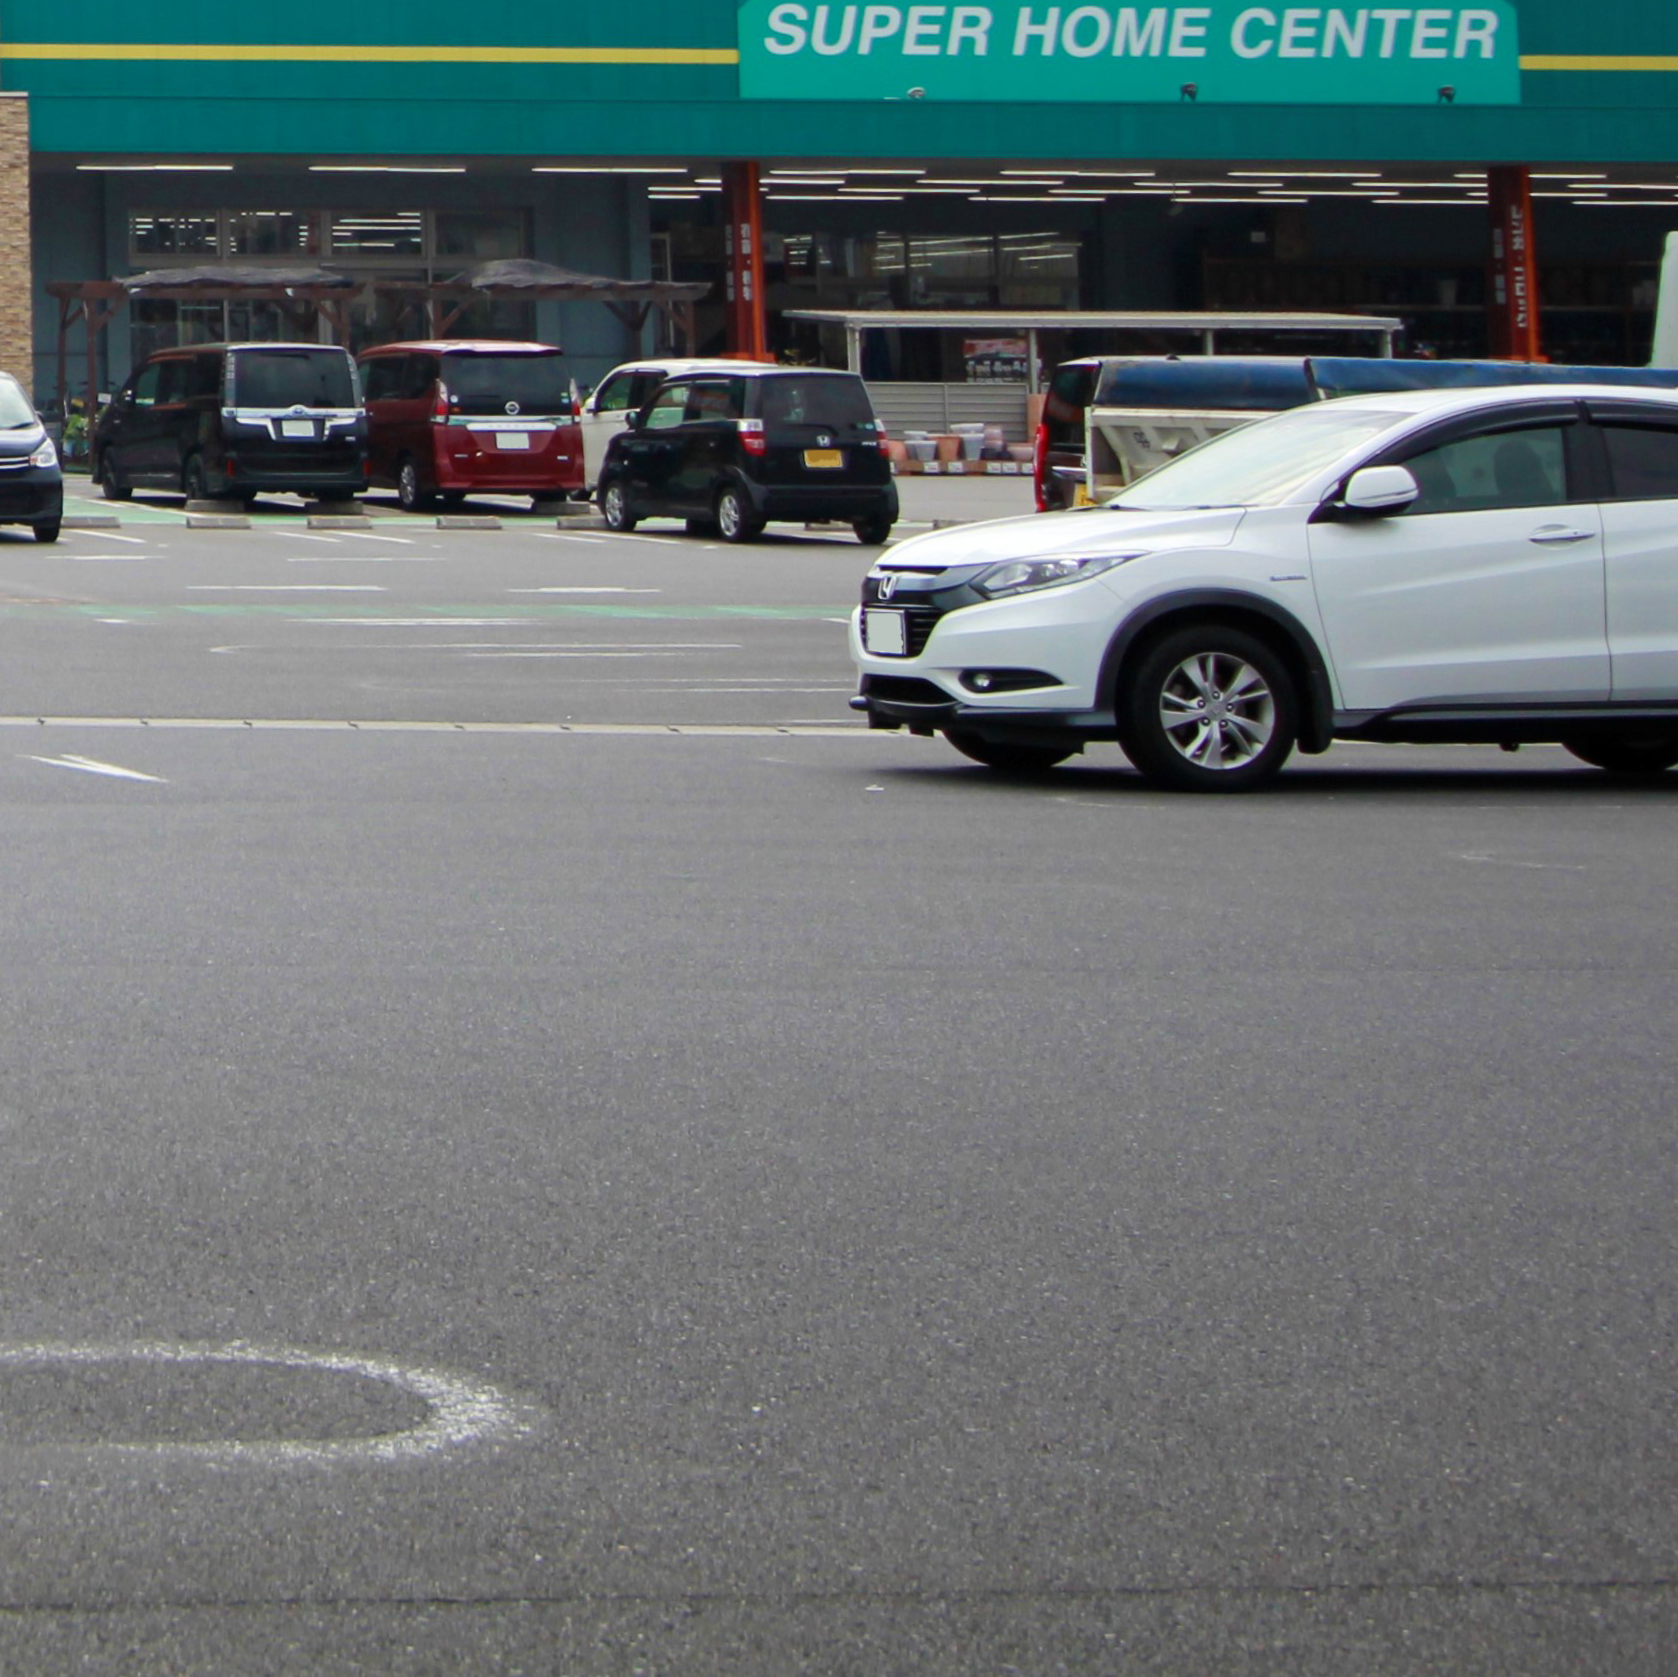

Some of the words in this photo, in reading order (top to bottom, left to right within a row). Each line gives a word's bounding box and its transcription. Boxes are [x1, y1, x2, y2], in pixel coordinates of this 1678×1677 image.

[763, 3, 993, 56] SUPER
[1012, 6, 1212, 58] HOME
[1230, 7, 1498, 59] CENTER
